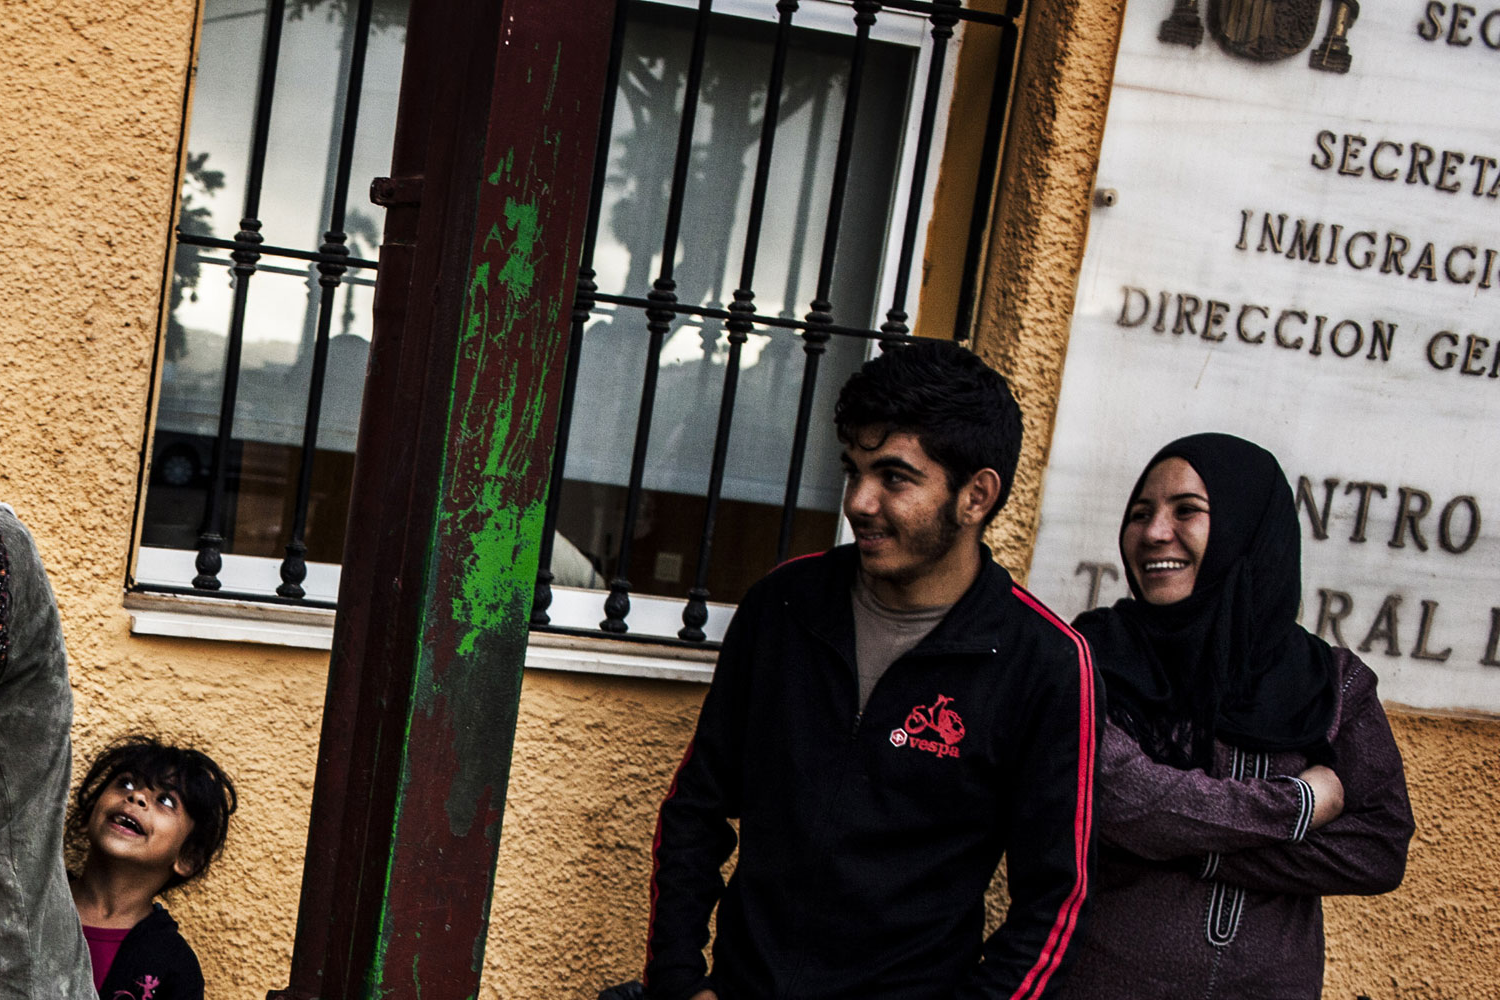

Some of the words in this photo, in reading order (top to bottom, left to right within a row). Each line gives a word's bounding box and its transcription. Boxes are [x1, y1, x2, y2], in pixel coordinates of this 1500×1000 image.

[1235, 209, 1500, 290] INMIGRACI
[1117, 286, 1398, 361] DIRECCION
[909, 737, 959, 758] vespa
